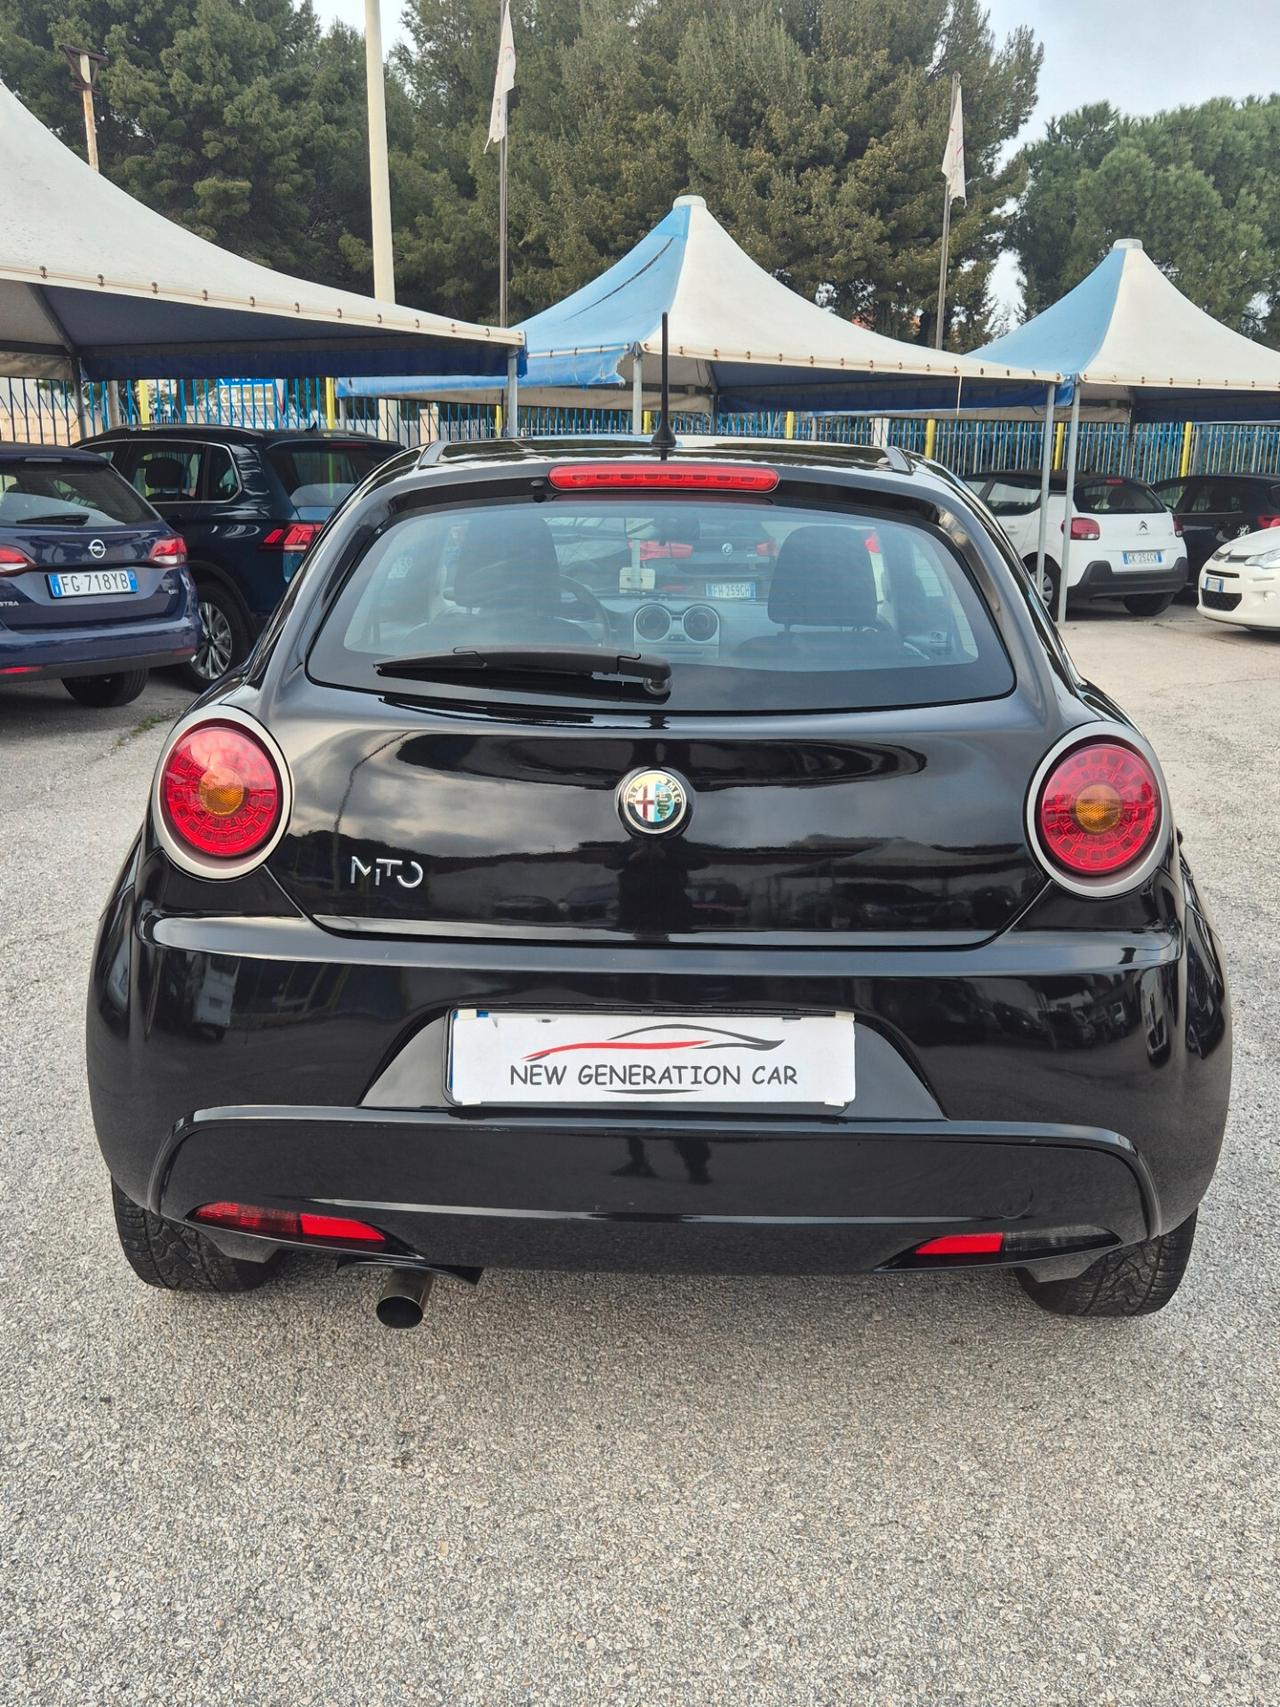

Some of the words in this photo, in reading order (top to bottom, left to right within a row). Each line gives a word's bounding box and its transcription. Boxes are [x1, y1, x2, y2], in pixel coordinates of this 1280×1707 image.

[60, 575, 80, 593] FG
[83, 573, 129, 592] 718YB
[510, 1064, 567, 1086] NEW
[577, 1064, 741, 1086] GENERATION
[751, 1065, 798, 1086] CAR
